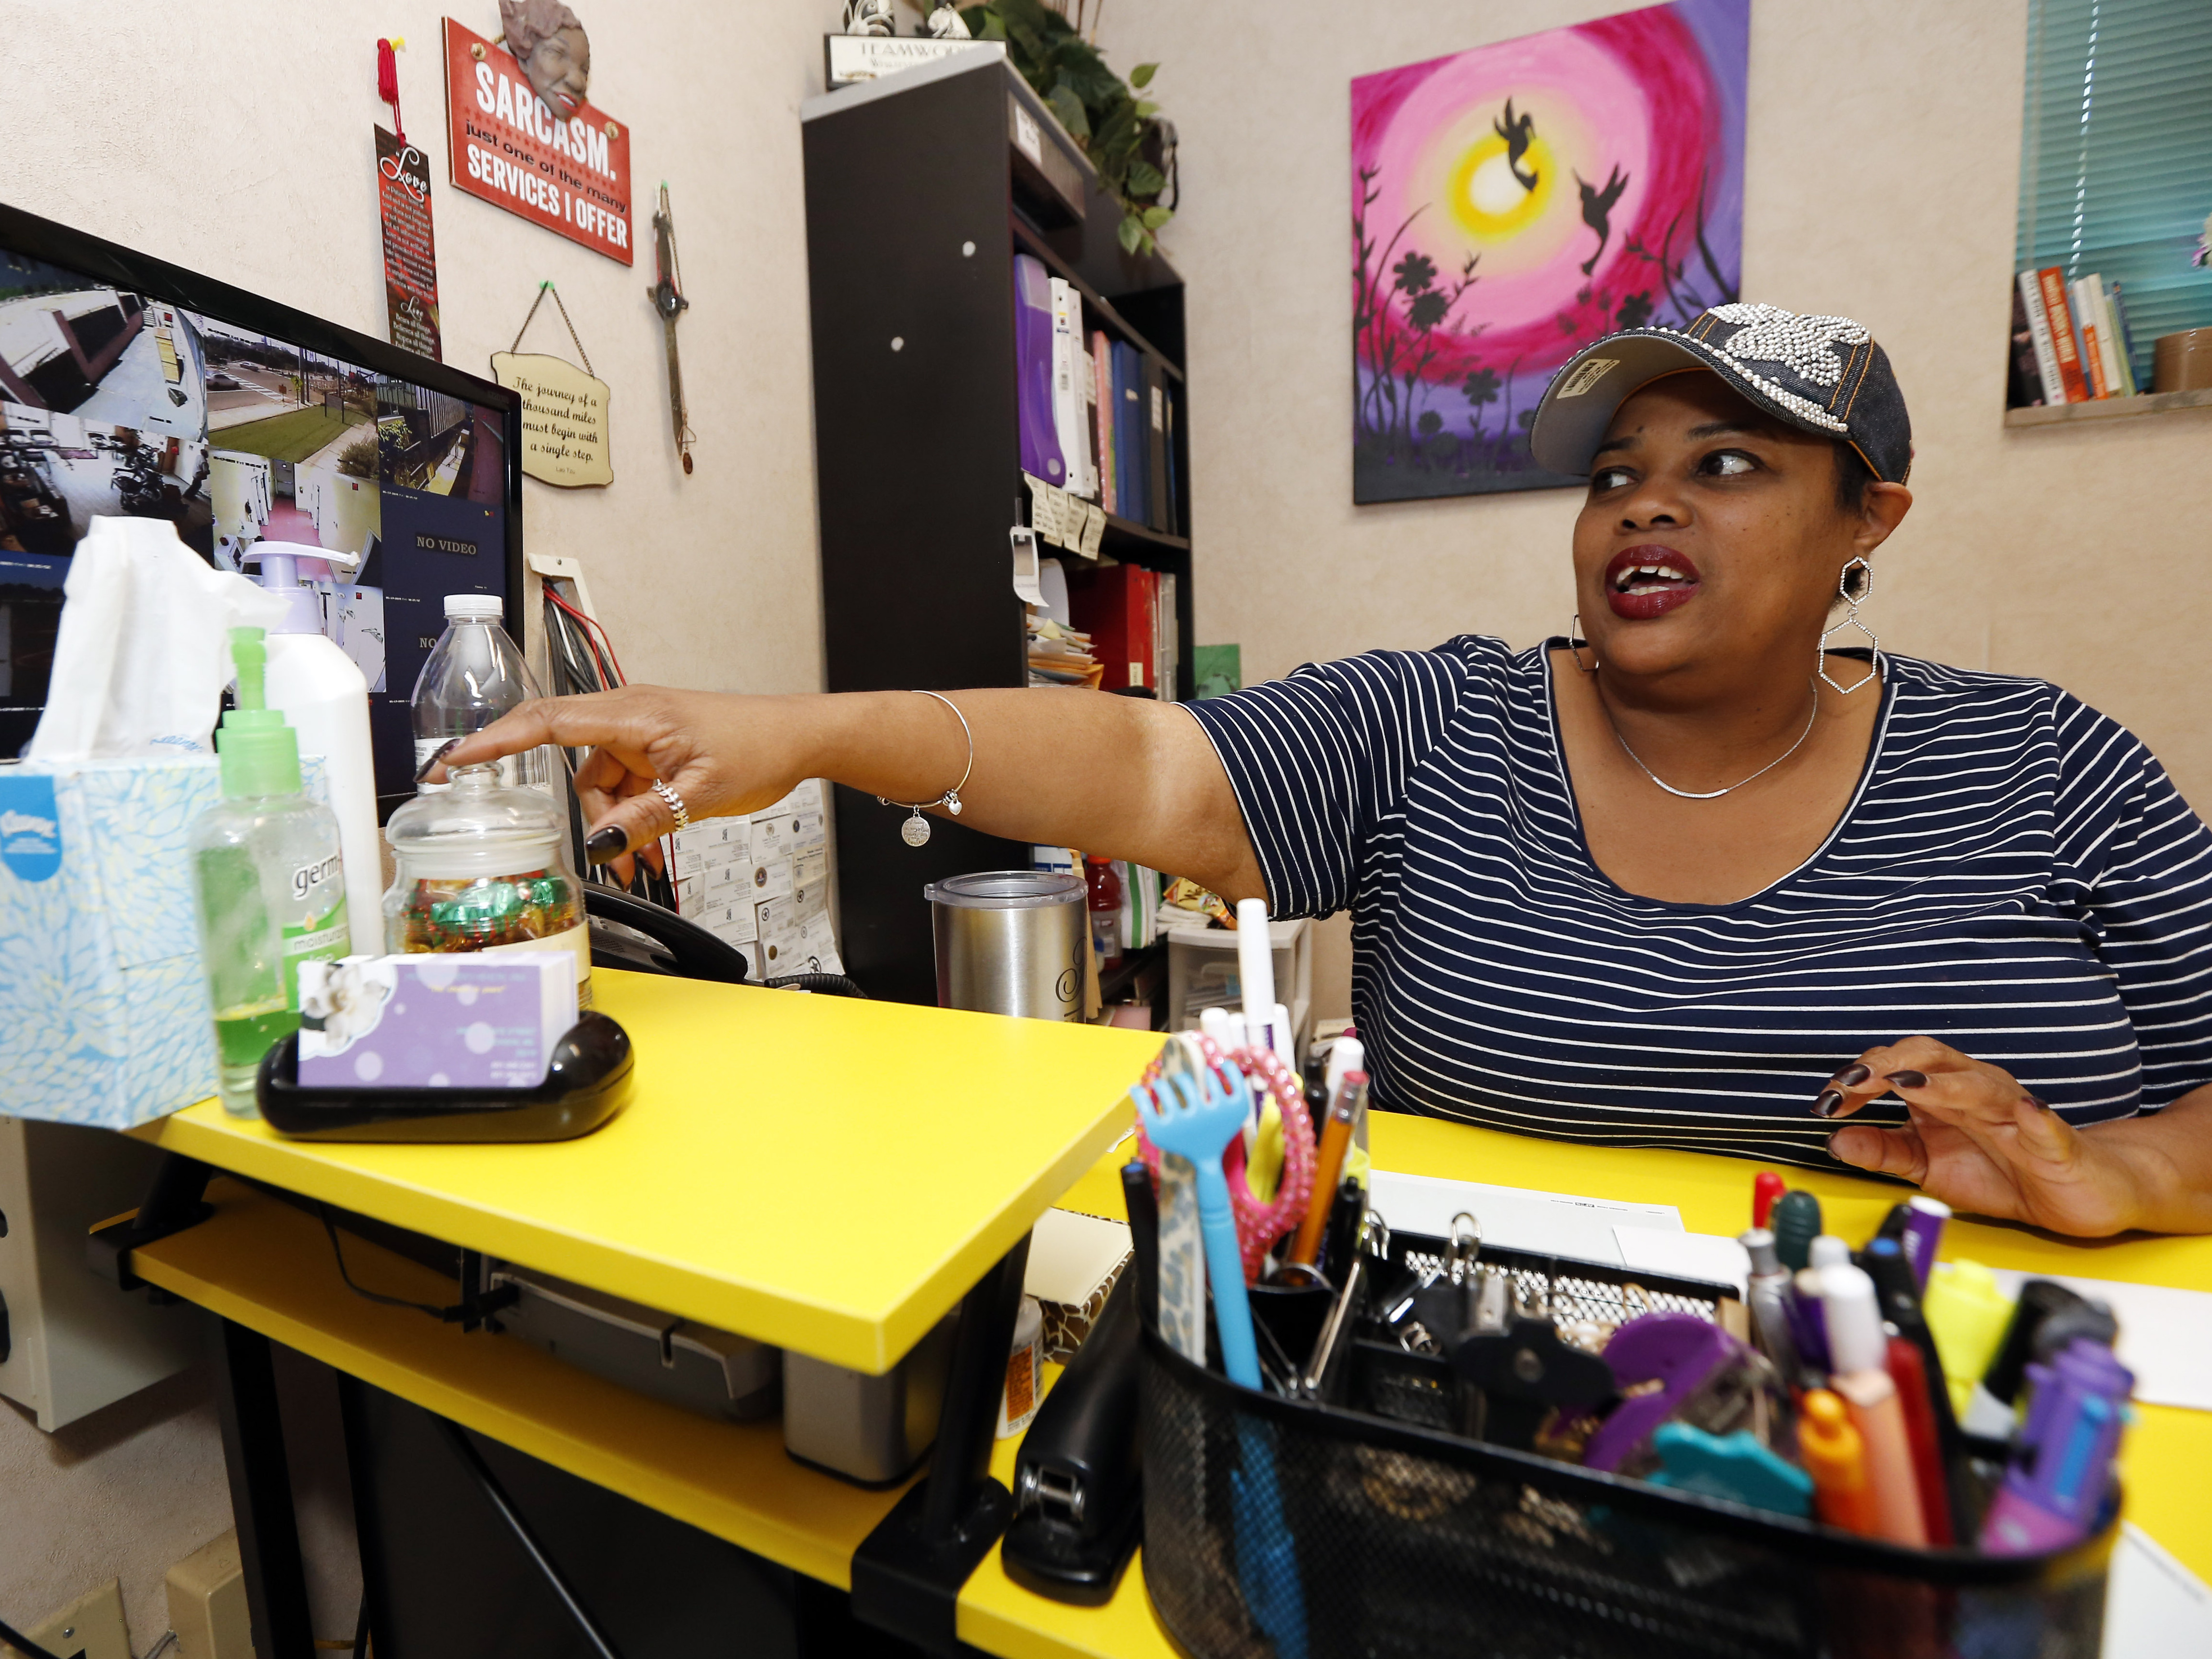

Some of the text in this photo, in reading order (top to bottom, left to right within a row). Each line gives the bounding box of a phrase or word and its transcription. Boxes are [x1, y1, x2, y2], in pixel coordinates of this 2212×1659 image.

[860, 42, 964, 57] TEAMWOR
[475, 61, 617, 181] SARCASM.
[380, 147, 428, 203] Love
[466, 120, 626, 213] just one of the many
[467, 143, 627, 249] SERVICES I OFFER
[513, 376, 533, 391] The
[536, 383, 575, 404] journey
[578, 393, 588, 407] of
[522, 398, 596, 424] thousand miles
[523, 421, 598, 443] must begin with
[530, 442, 593, 463] a single step.
[417, 536, 476, 555] NO VIDEO
[419, 638, 437, 648] NO
